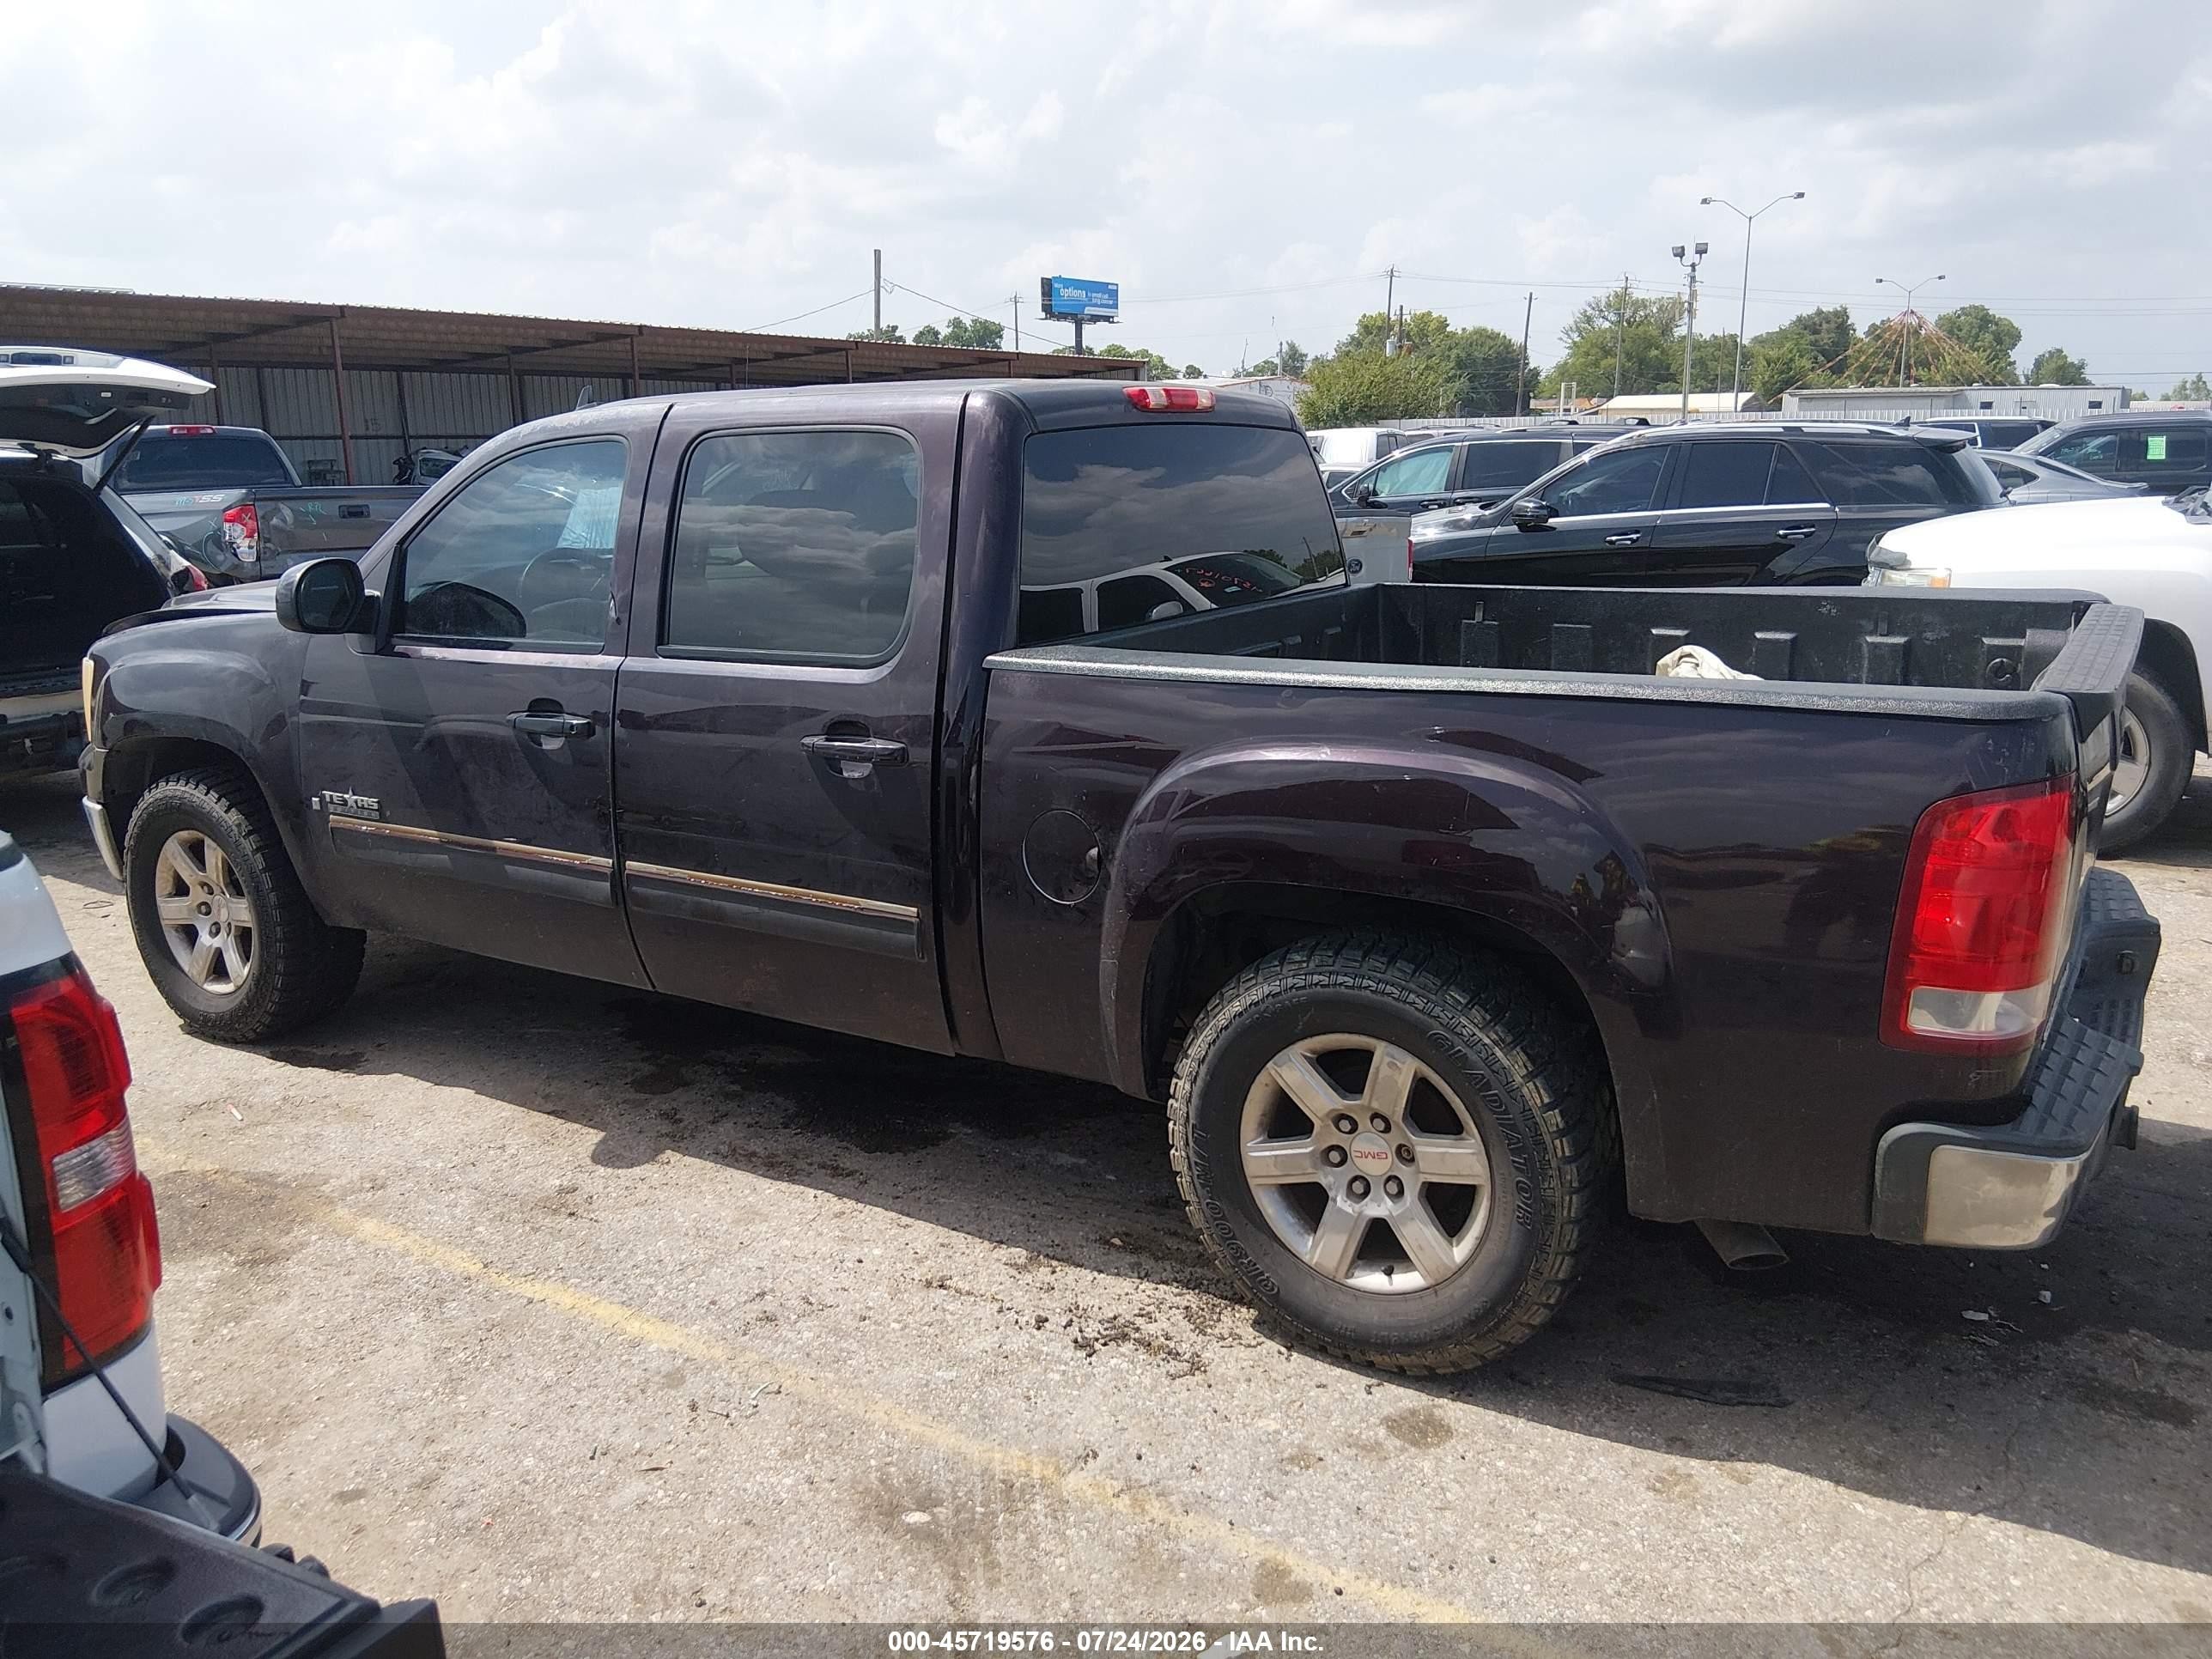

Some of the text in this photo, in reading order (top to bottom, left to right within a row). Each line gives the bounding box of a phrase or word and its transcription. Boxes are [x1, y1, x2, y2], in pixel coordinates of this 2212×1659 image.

[1060, 286, 1086, 299] options
[321, 787, 380, 810] TEXAS
[1425, 1030, 1534, 1231] GLADIATOR
[1352, 1149, 1389, 1160] GMC
